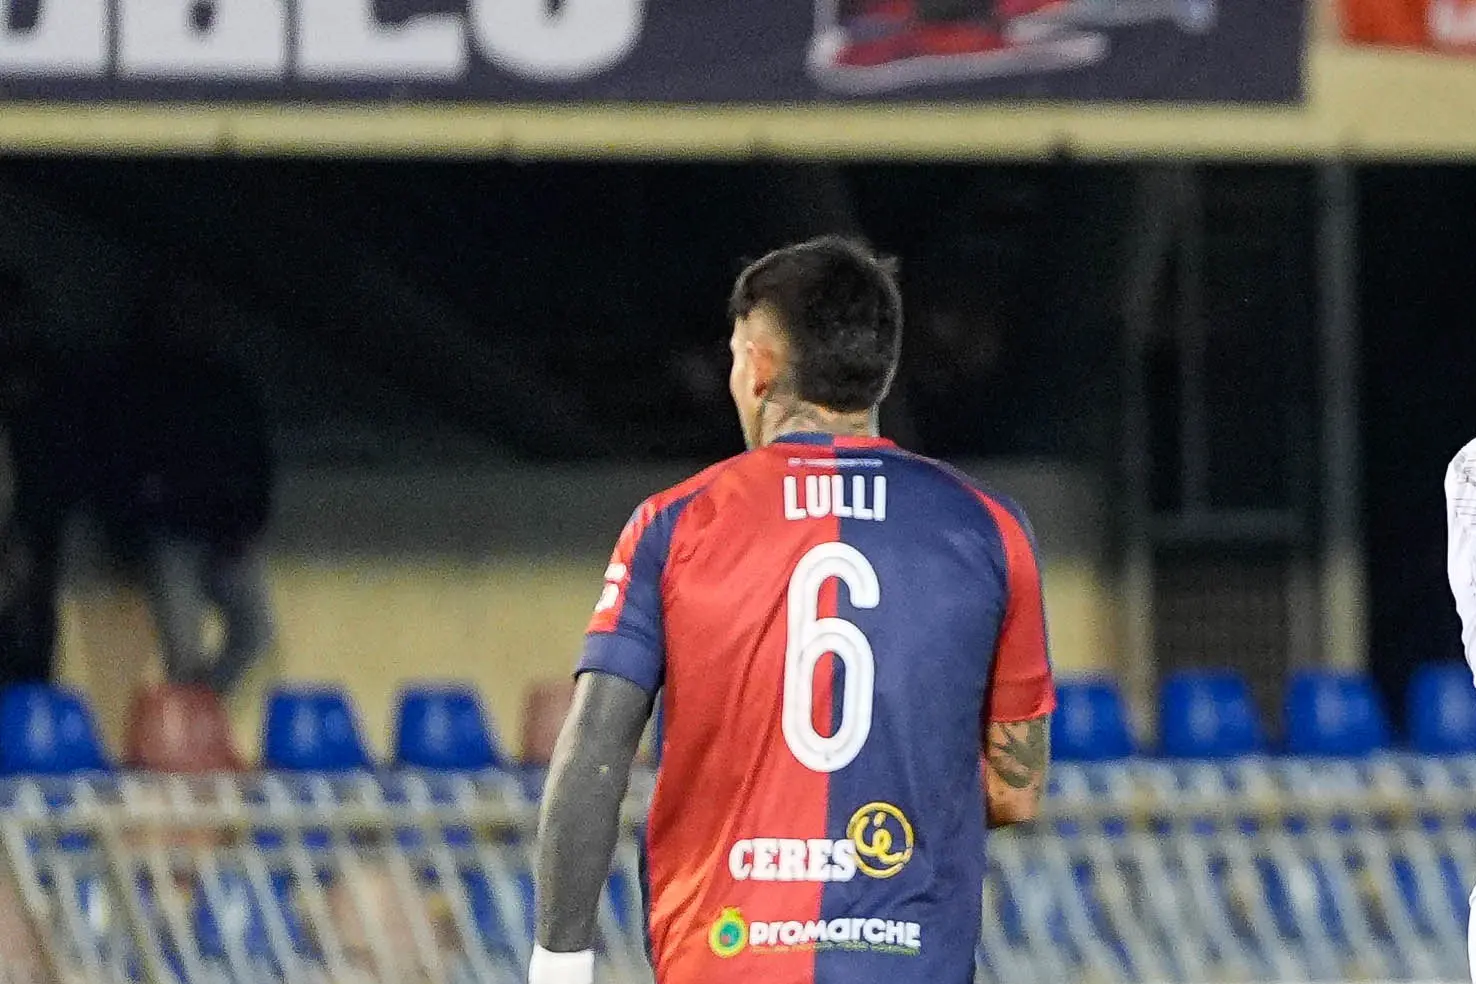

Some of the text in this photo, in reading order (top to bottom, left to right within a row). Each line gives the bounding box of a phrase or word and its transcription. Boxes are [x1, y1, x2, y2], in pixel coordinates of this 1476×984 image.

[783, 474, 887, 522] LULLI
[782, 541, 880, 772] 6
[728, 838, 857, 882] CERES
